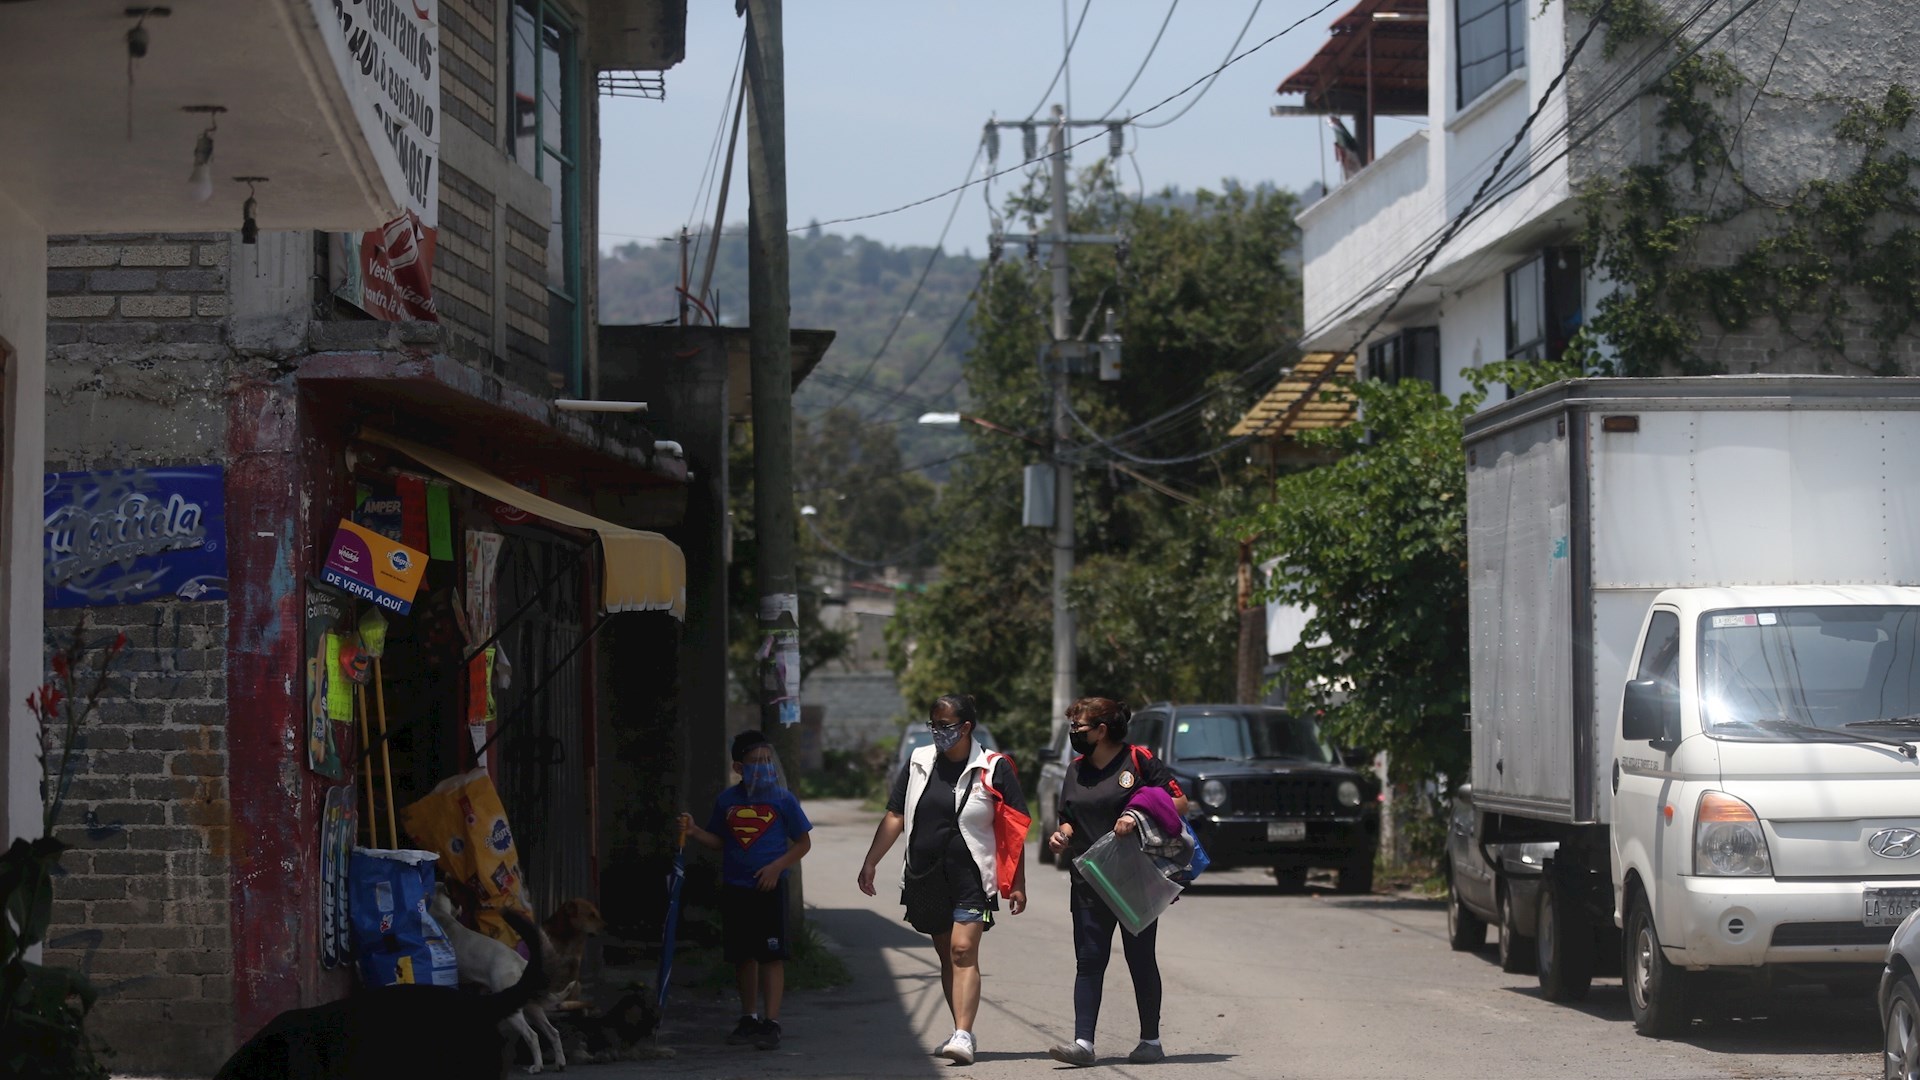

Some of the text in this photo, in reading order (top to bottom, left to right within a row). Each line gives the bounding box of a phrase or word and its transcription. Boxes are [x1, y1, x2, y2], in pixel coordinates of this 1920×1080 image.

[363, 500, 402, 514] AMPER
[386, 551, 414, 569] Pedigree
[326, 572, 340, 586] DE
[343, 578, 374, 601] VENTA
[375, 594, 404, 612] AQUÍ
[1865, 899, 1920, 917] LA-66-5
